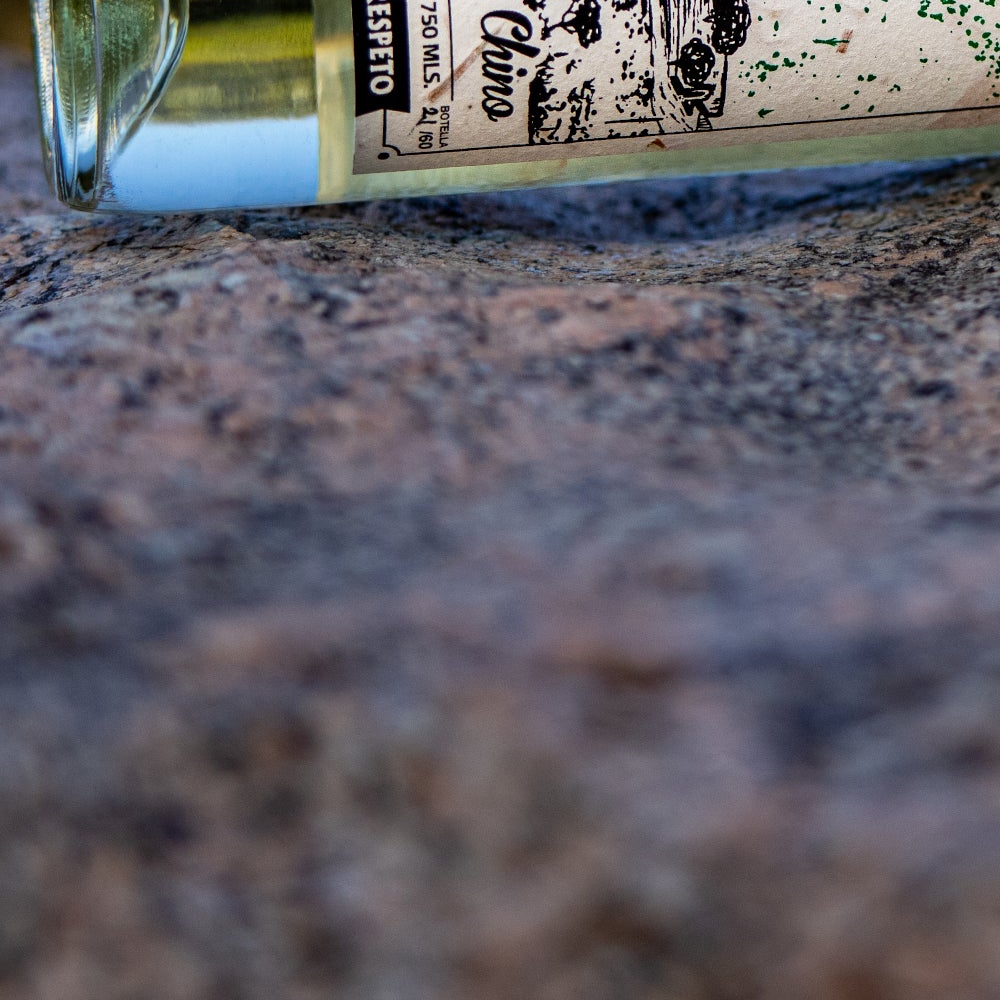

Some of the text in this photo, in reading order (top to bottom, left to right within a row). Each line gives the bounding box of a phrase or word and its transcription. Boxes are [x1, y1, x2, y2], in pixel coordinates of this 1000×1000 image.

[420, 1, 441, 89] 750 MLS.
[480, 9, 540, 122] Chino
[438, 105, 450, 149] BOTELLA
